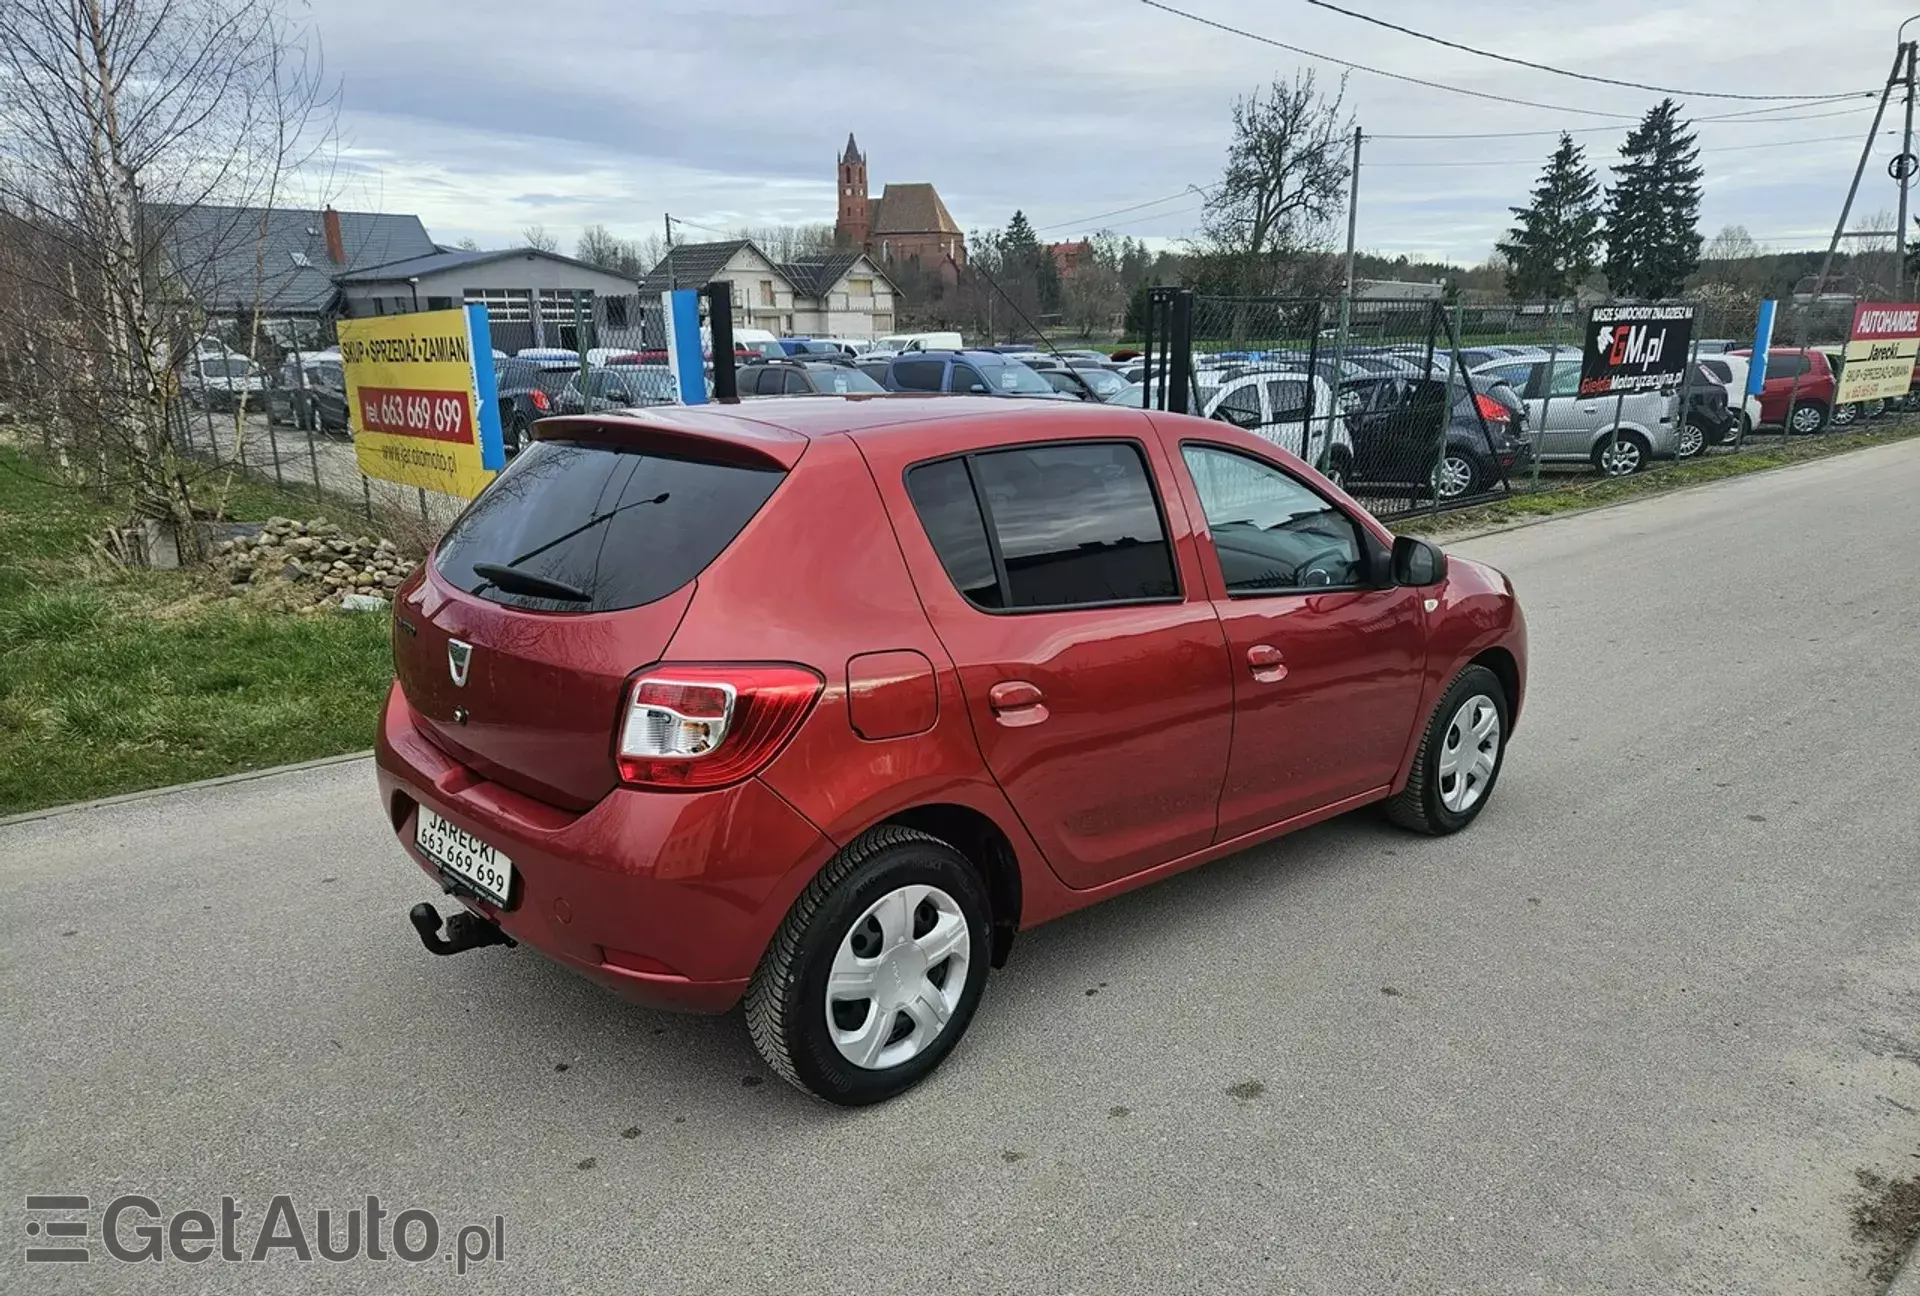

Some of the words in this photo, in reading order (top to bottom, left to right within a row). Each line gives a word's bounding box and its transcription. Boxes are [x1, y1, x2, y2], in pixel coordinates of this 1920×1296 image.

[1857, 311, 1919, 333] AUTOHANDEL
[342, 341, 364, 364] SKUP
[1608, 325, 1667, 372] GM.pl
[1868, 343, 1900, 361] Jarecki
[381, 394, 405, 426] 663
[407, 396, 431, 429] 669
[434, 398, 462, 433] 699
[429, 814, 496, 865] JARECKI
[421, 828, 443, 855] 663
[447, 846, 472, 872] 669
[477, 864, 504, 892] 699
